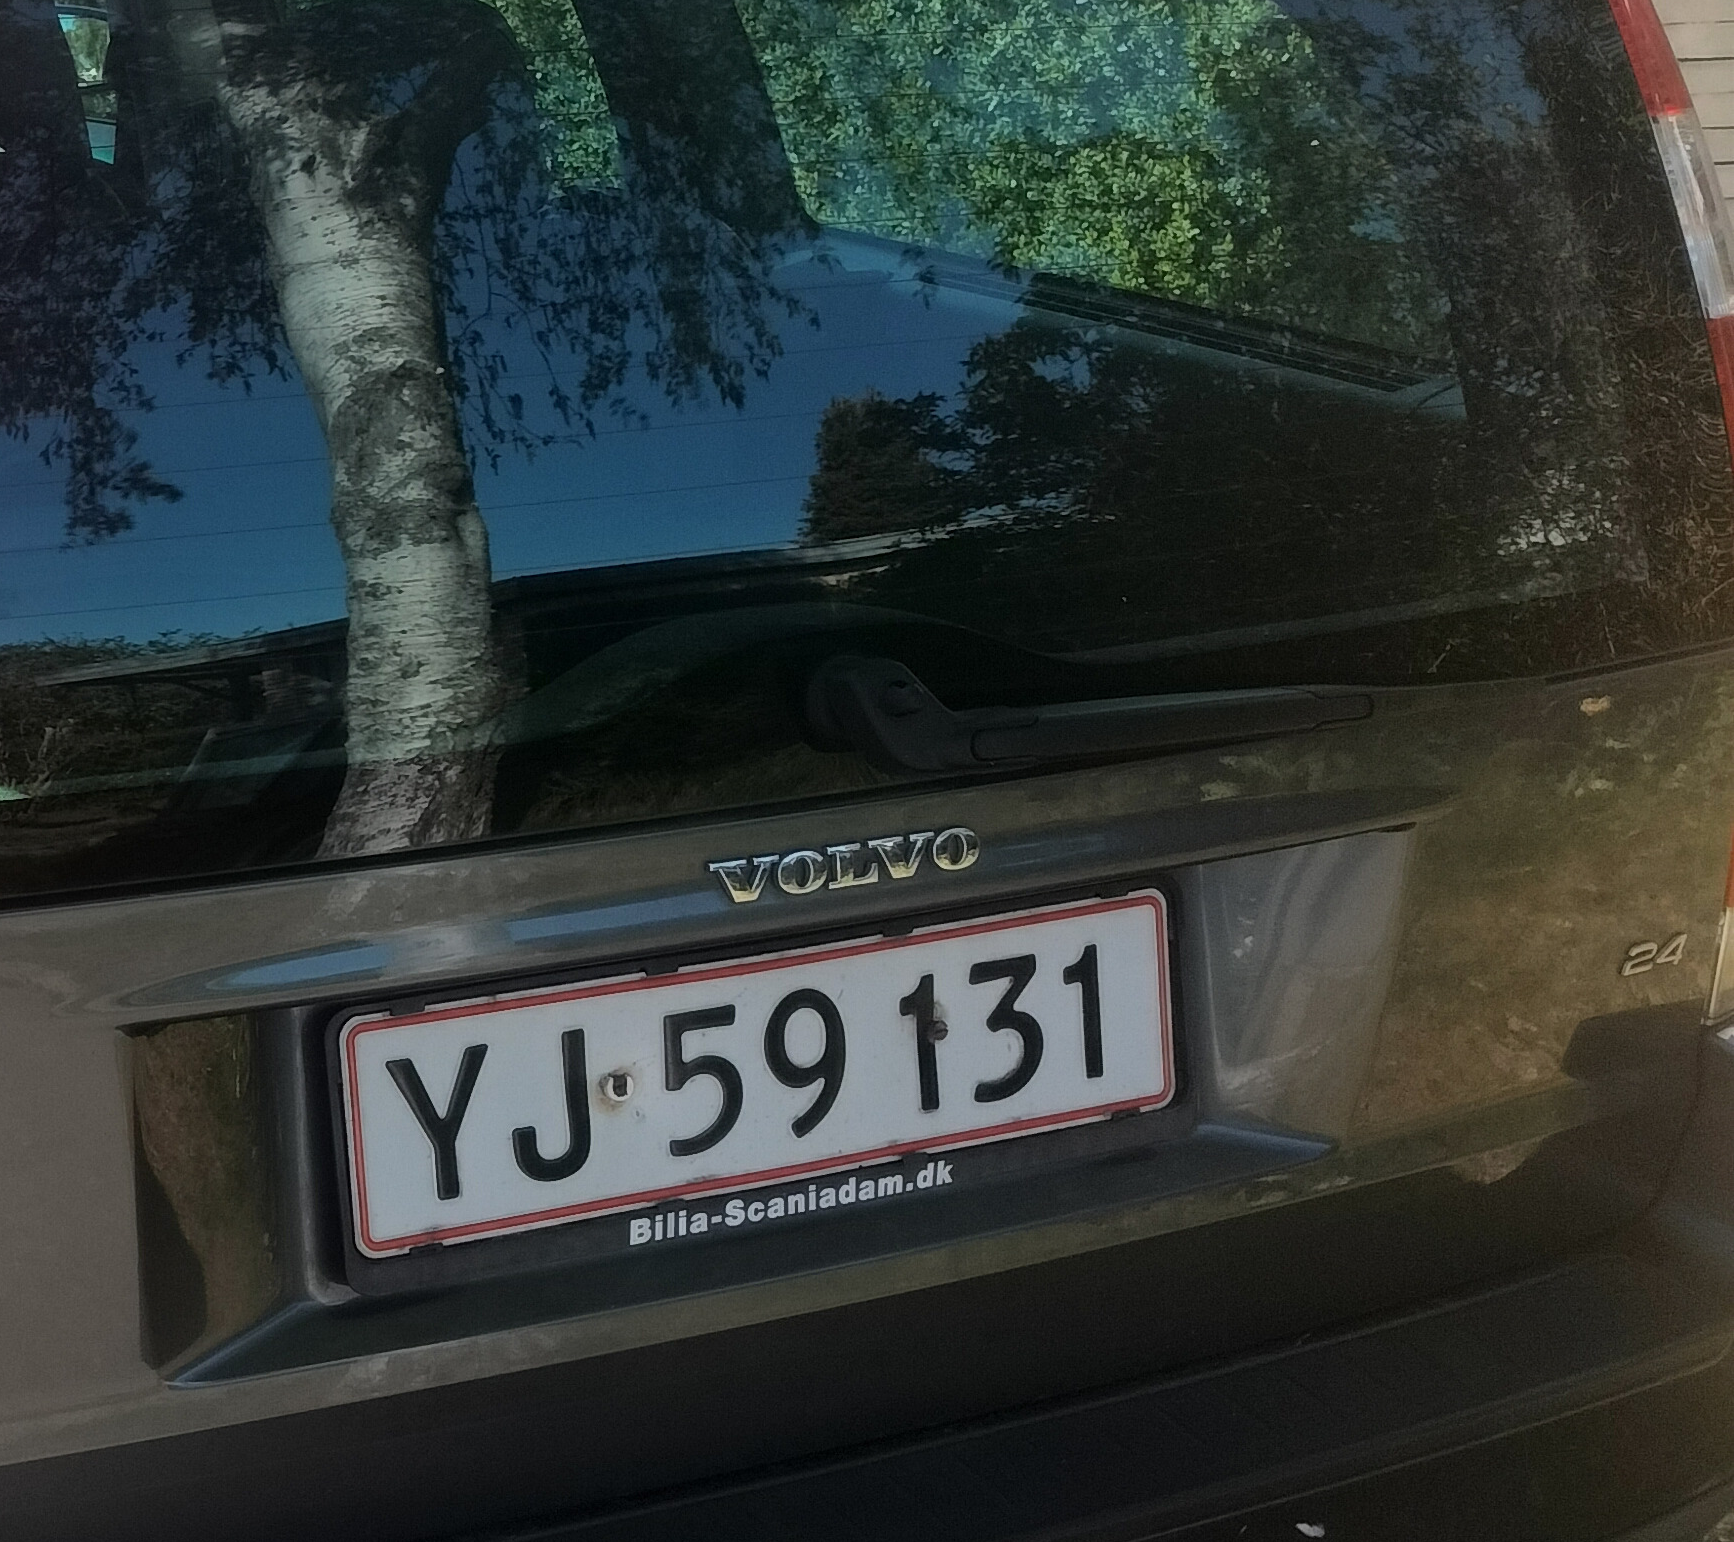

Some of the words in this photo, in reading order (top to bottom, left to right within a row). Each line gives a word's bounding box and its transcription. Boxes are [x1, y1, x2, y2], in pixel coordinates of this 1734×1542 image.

[708, 825, 981, 905] VOLVO
[385, 1027, 592, 1201] YJ
[662, 987, 848, 1159] 59
[898, 942, 1106, 1115] 131
[628, 1159, 955, 1248] Bilia-Scaniadam.dk
